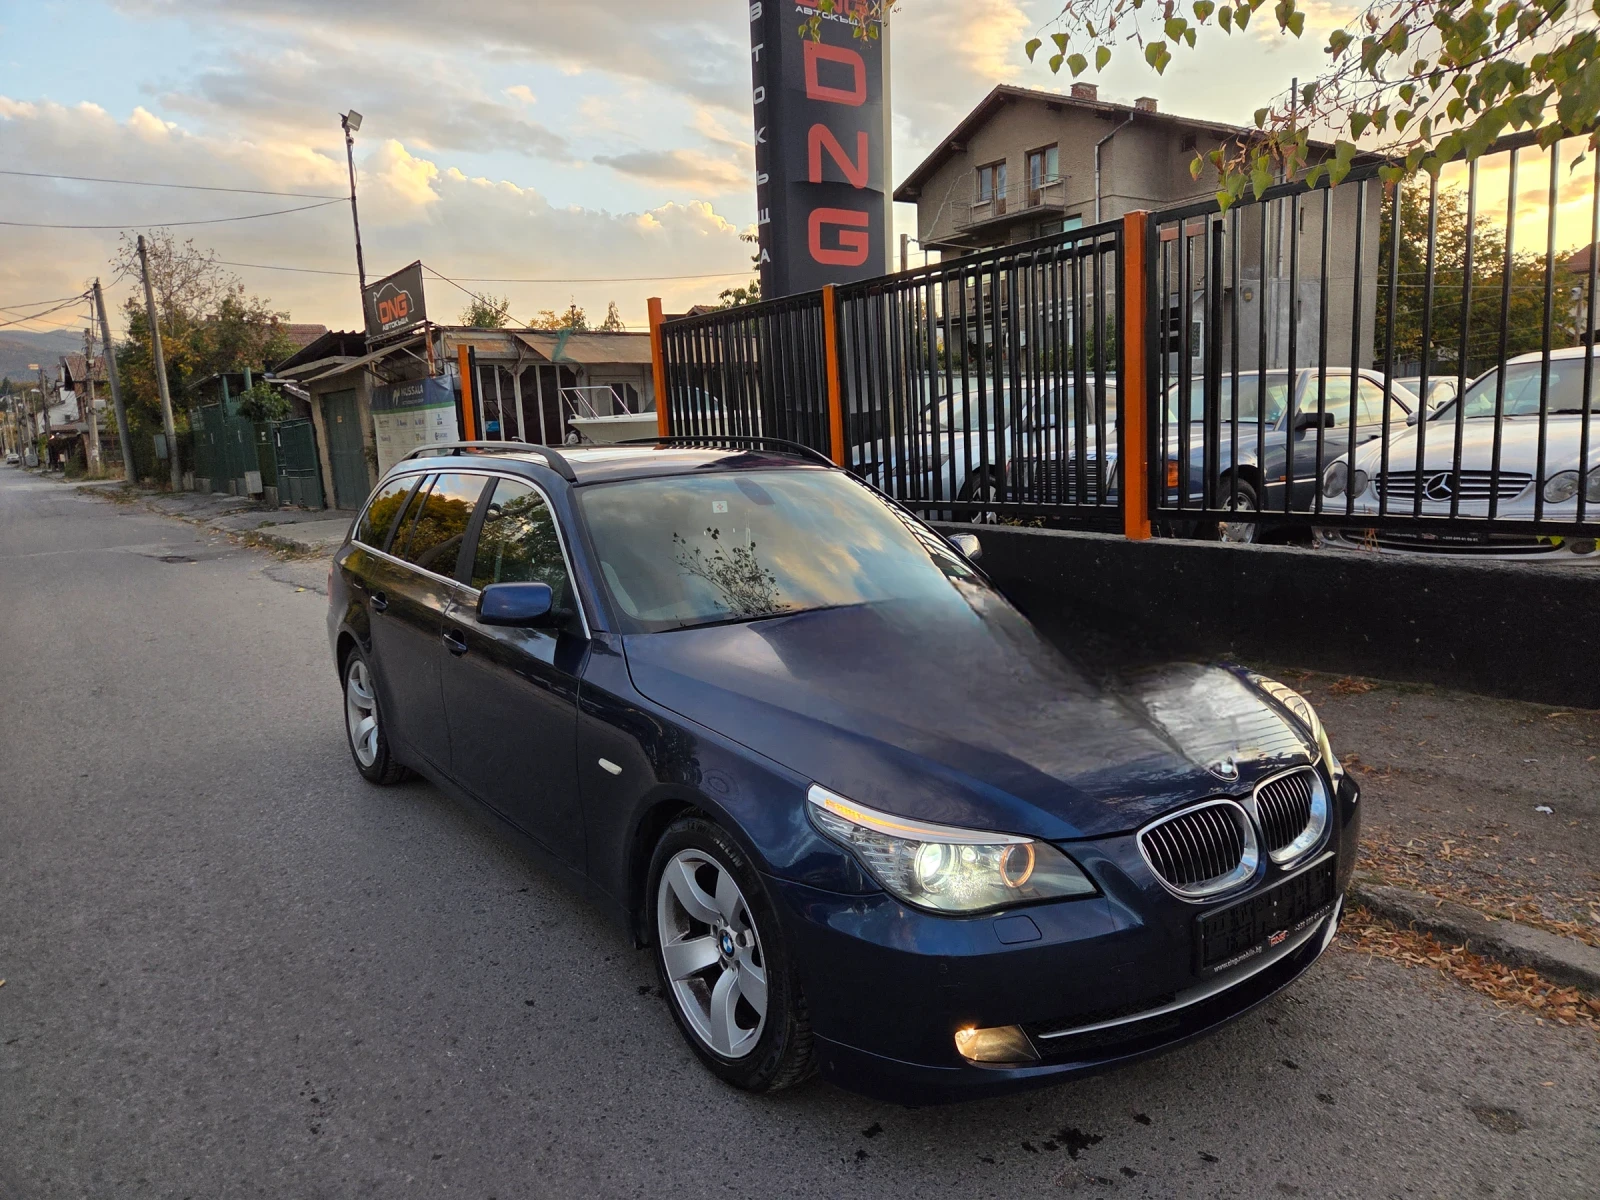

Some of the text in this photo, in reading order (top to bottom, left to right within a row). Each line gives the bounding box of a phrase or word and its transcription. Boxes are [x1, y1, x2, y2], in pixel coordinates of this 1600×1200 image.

[795, 5, 870, 27] АВТОКЪЩ
[803, 39, 869, 267] DNG
[378, 293, 408, 324] DNG
